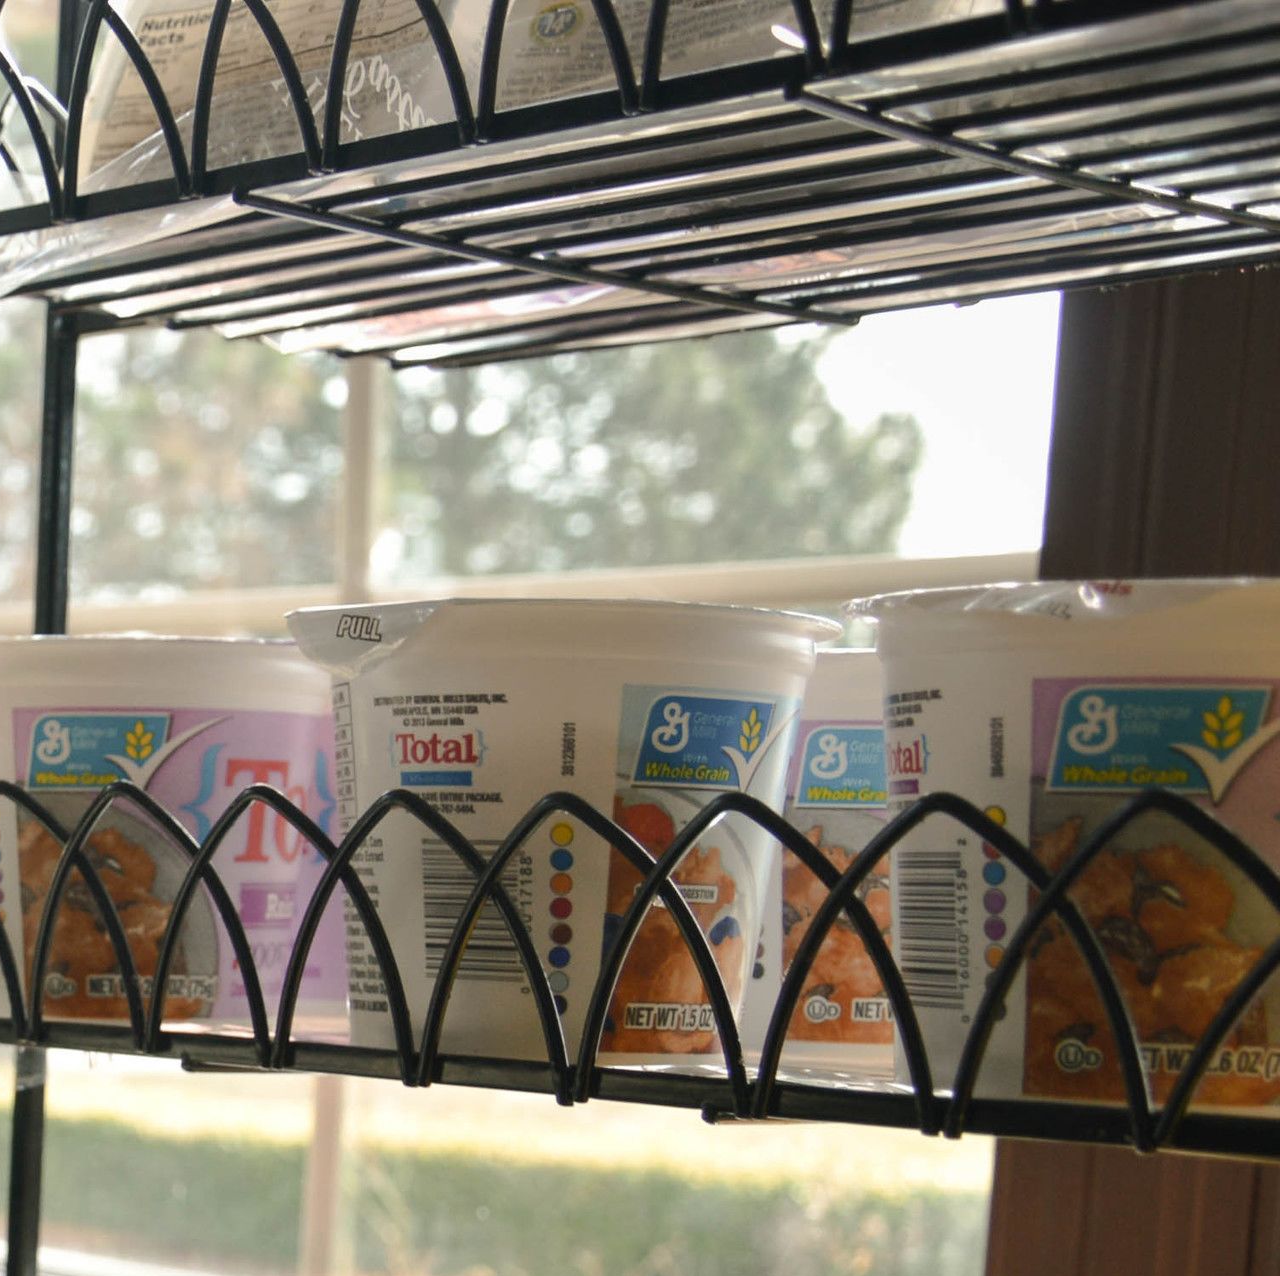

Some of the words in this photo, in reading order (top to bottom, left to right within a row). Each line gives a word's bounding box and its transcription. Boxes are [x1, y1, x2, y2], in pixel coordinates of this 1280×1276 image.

[143, 13, 213, 32] Nutritio
[336, 614, 382, 642] PULL
[395, 732, 478, 764] Total
[645, 763, 693, 780] Whole
[695, 766, 730, 782] Grain
[1064, 765, 1128, 783] Whole
[1131, 766, 1187, 784] Grain
[807, 786, 855, 801] Whole
[626, 1006, 653, 1026] NET
[656, 1007, 678, 1027] WT
[681, 1008, 697, 1028] 1.5
[698, 1009, 714, 1028] OZ
[854, 1002, 883, 1019] NET
[1237, 1051, 1259, 1074] OZ
